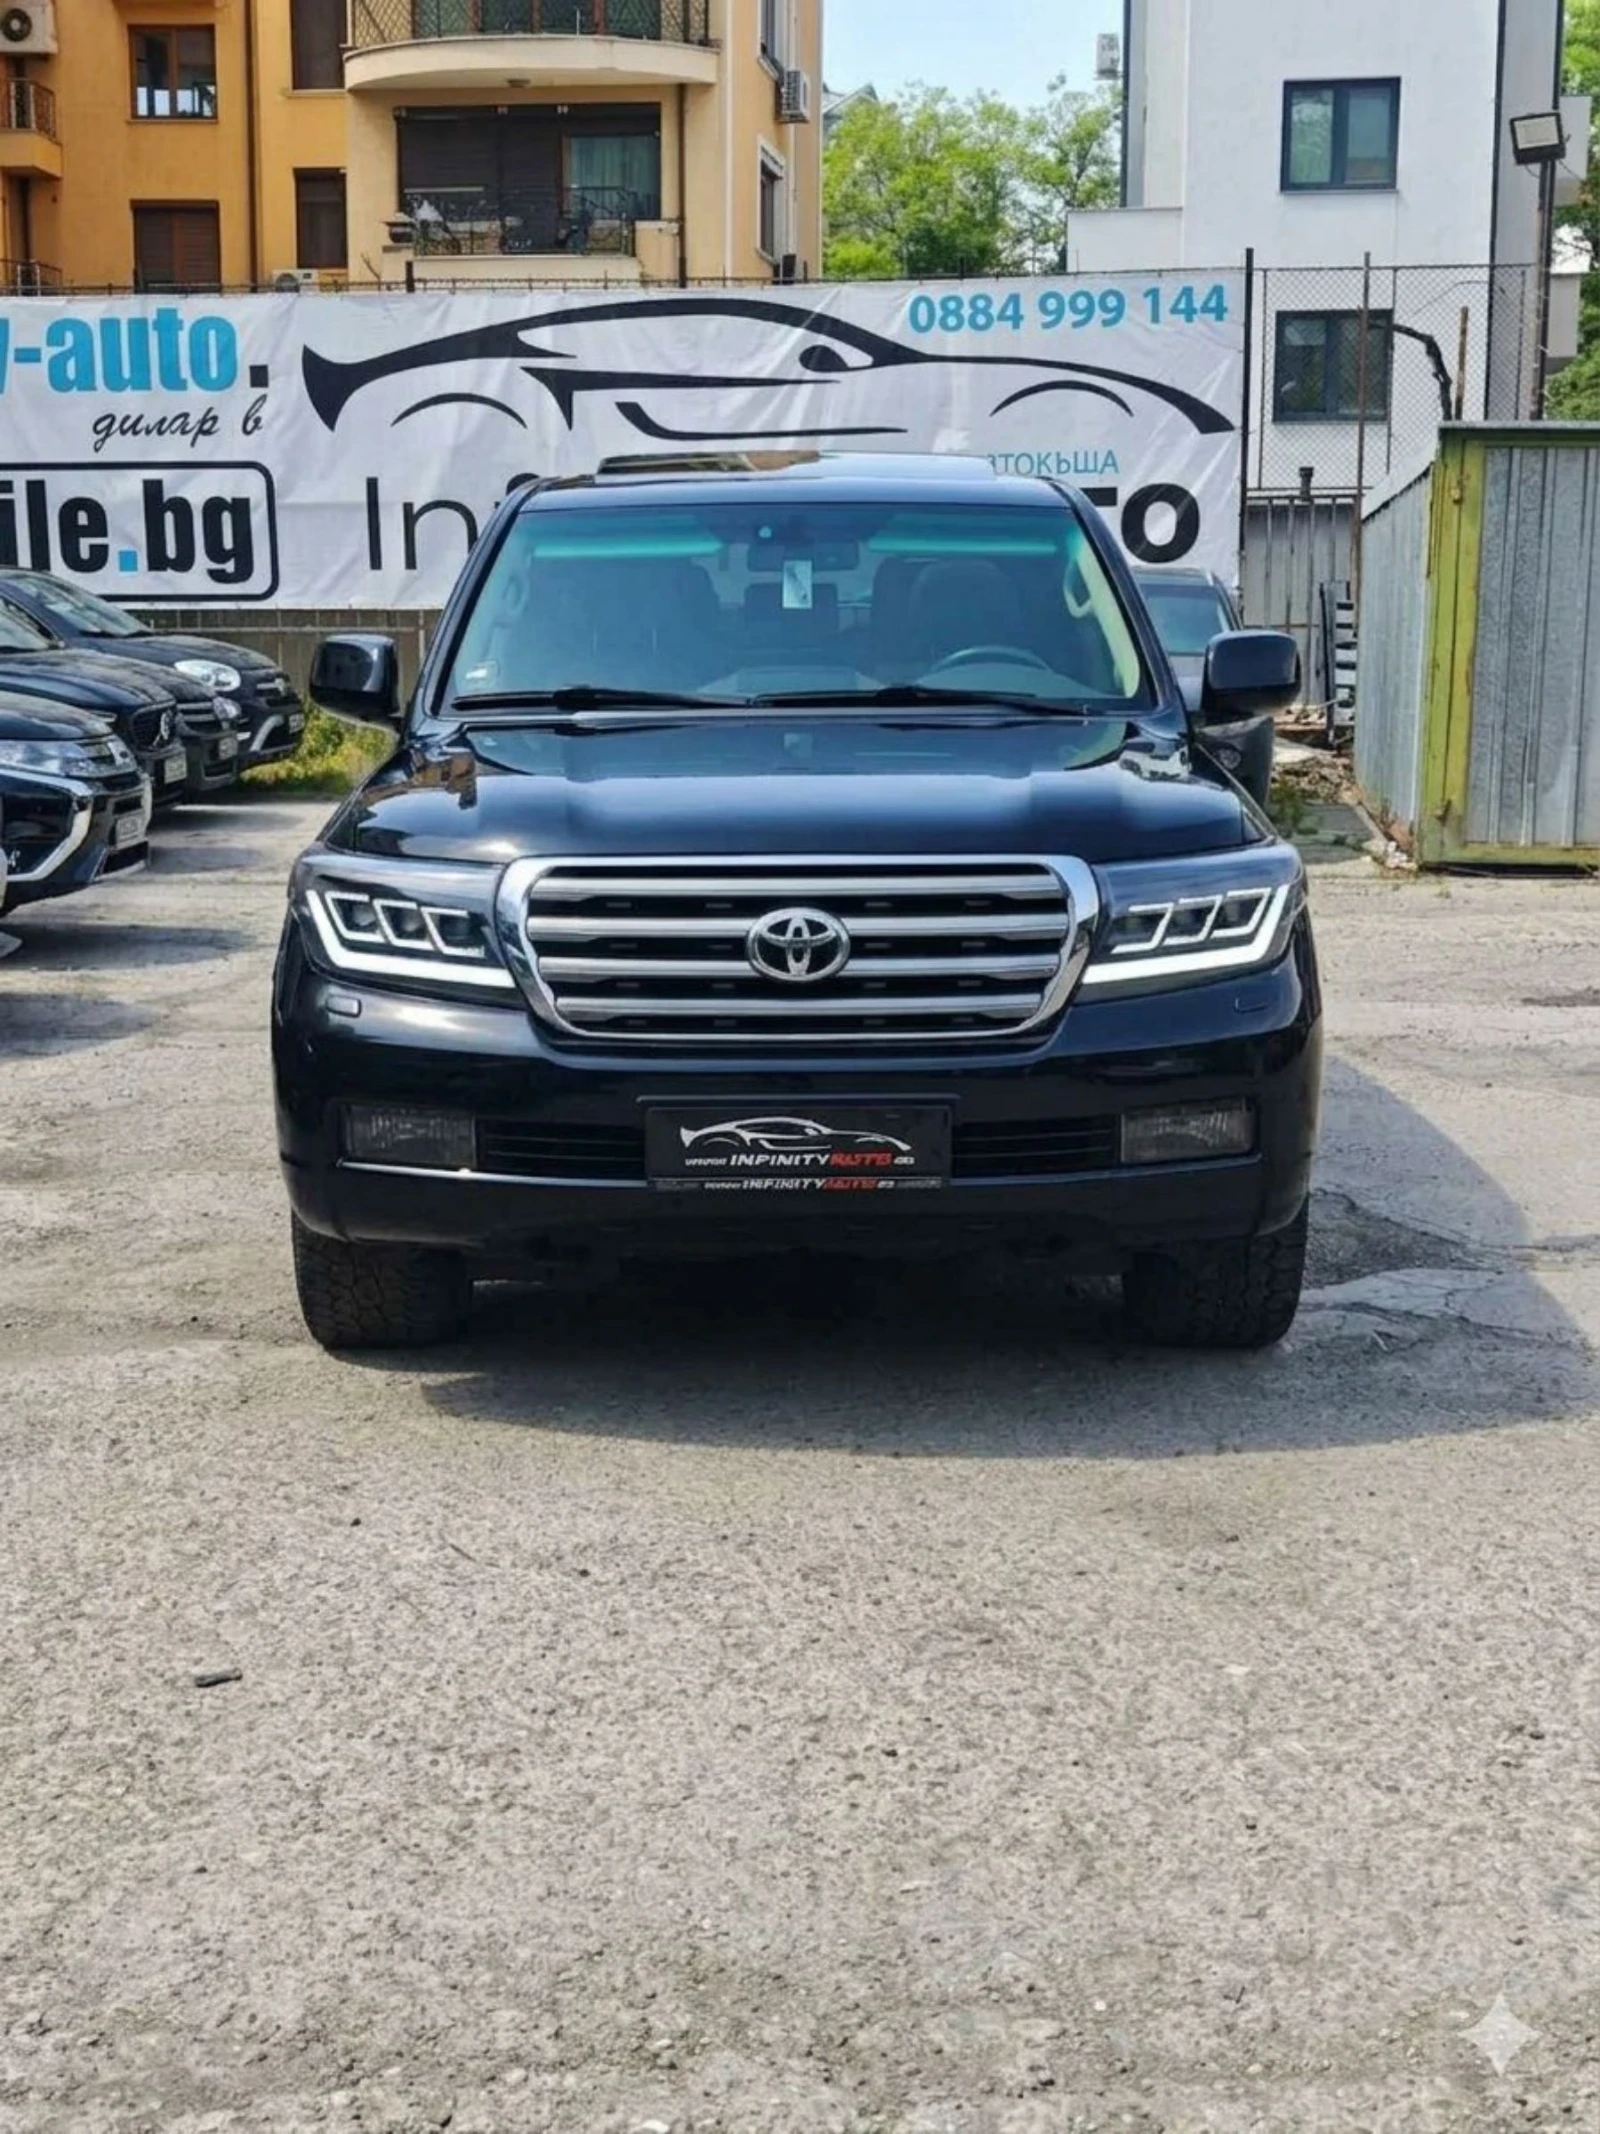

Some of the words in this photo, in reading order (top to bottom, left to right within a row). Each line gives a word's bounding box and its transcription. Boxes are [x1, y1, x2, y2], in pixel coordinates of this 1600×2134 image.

[909, 293, 1024, 333] 0884
[1039, 288, 1126, 329] 999
[1144, 285, 1228, 324] 144
[93, 407, 220, 453] дилар
